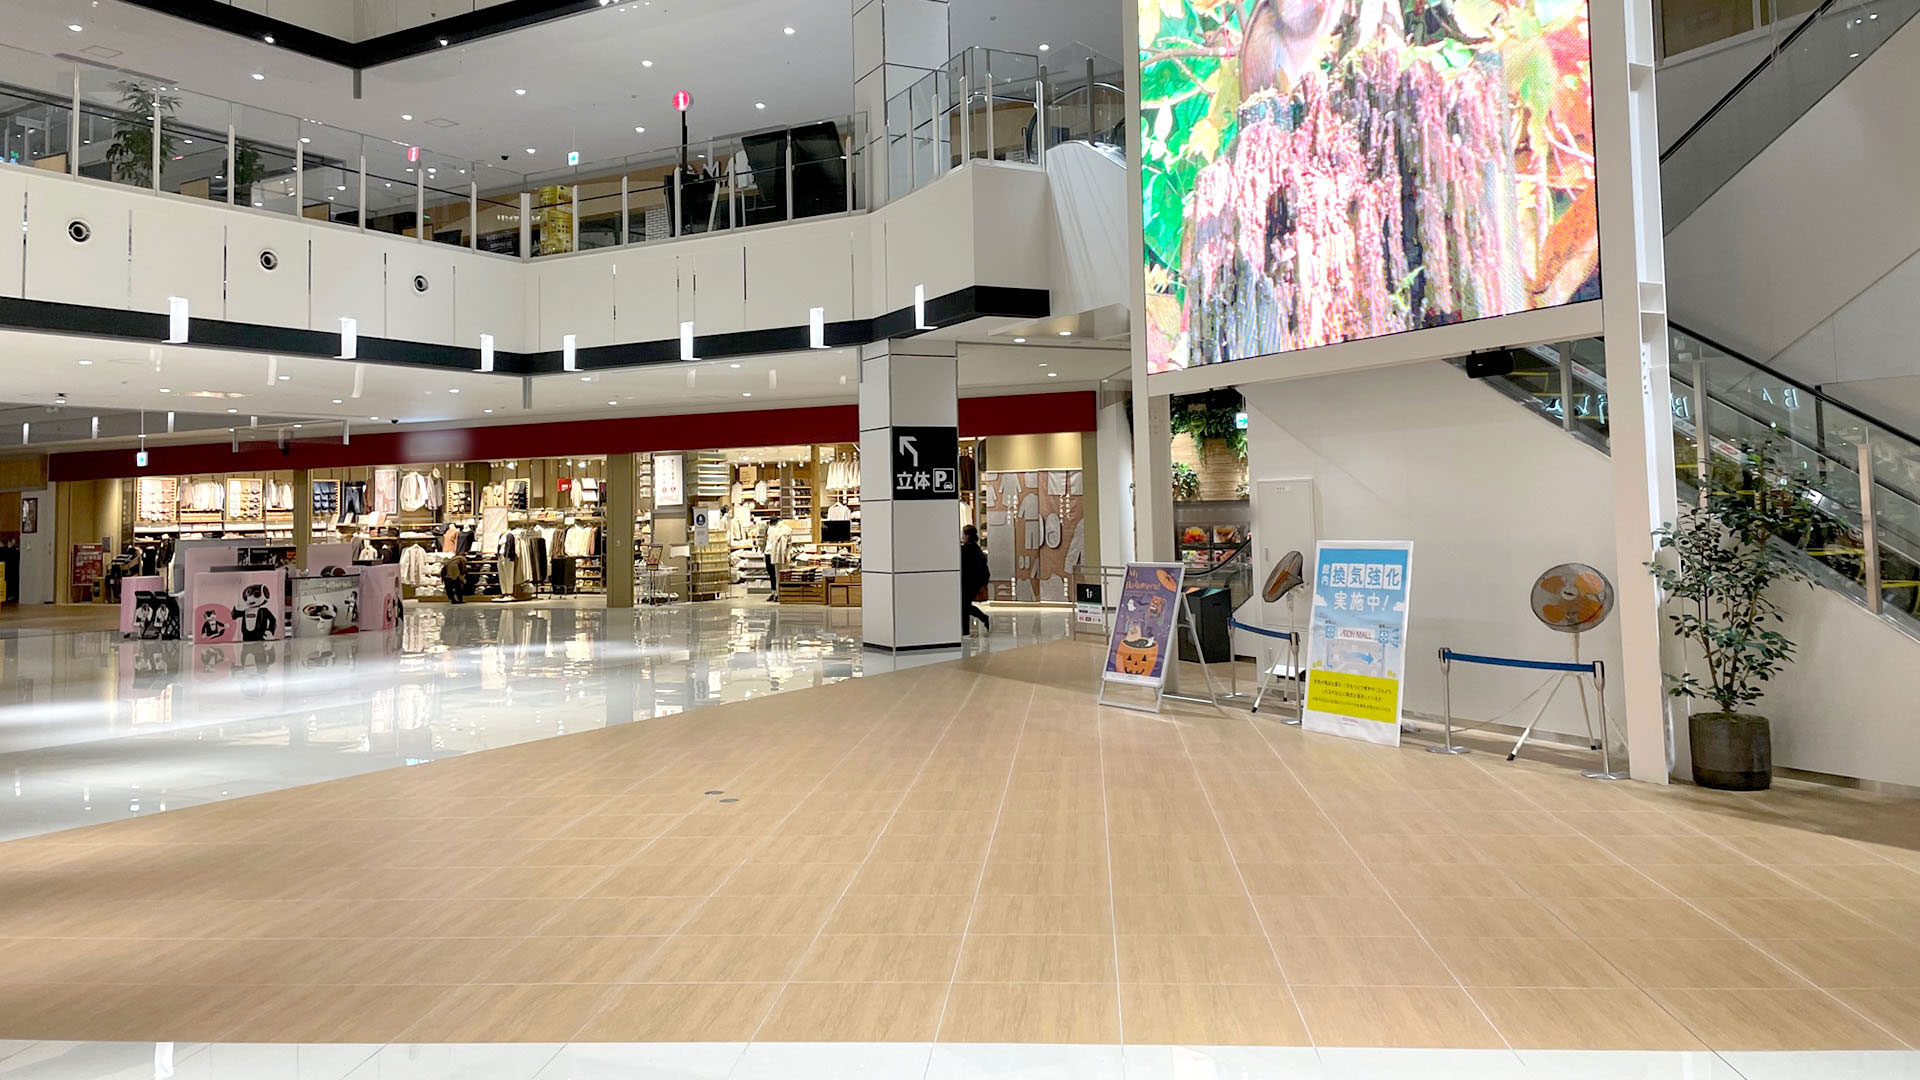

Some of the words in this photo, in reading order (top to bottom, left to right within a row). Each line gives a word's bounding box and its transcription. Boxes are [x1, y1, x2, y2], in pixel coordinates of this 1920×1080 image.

[896, 471, 931, 490] 立体
[1332, 565, 1400, 588] 換気強化
[1085, 588, 1093, 599] 1F
